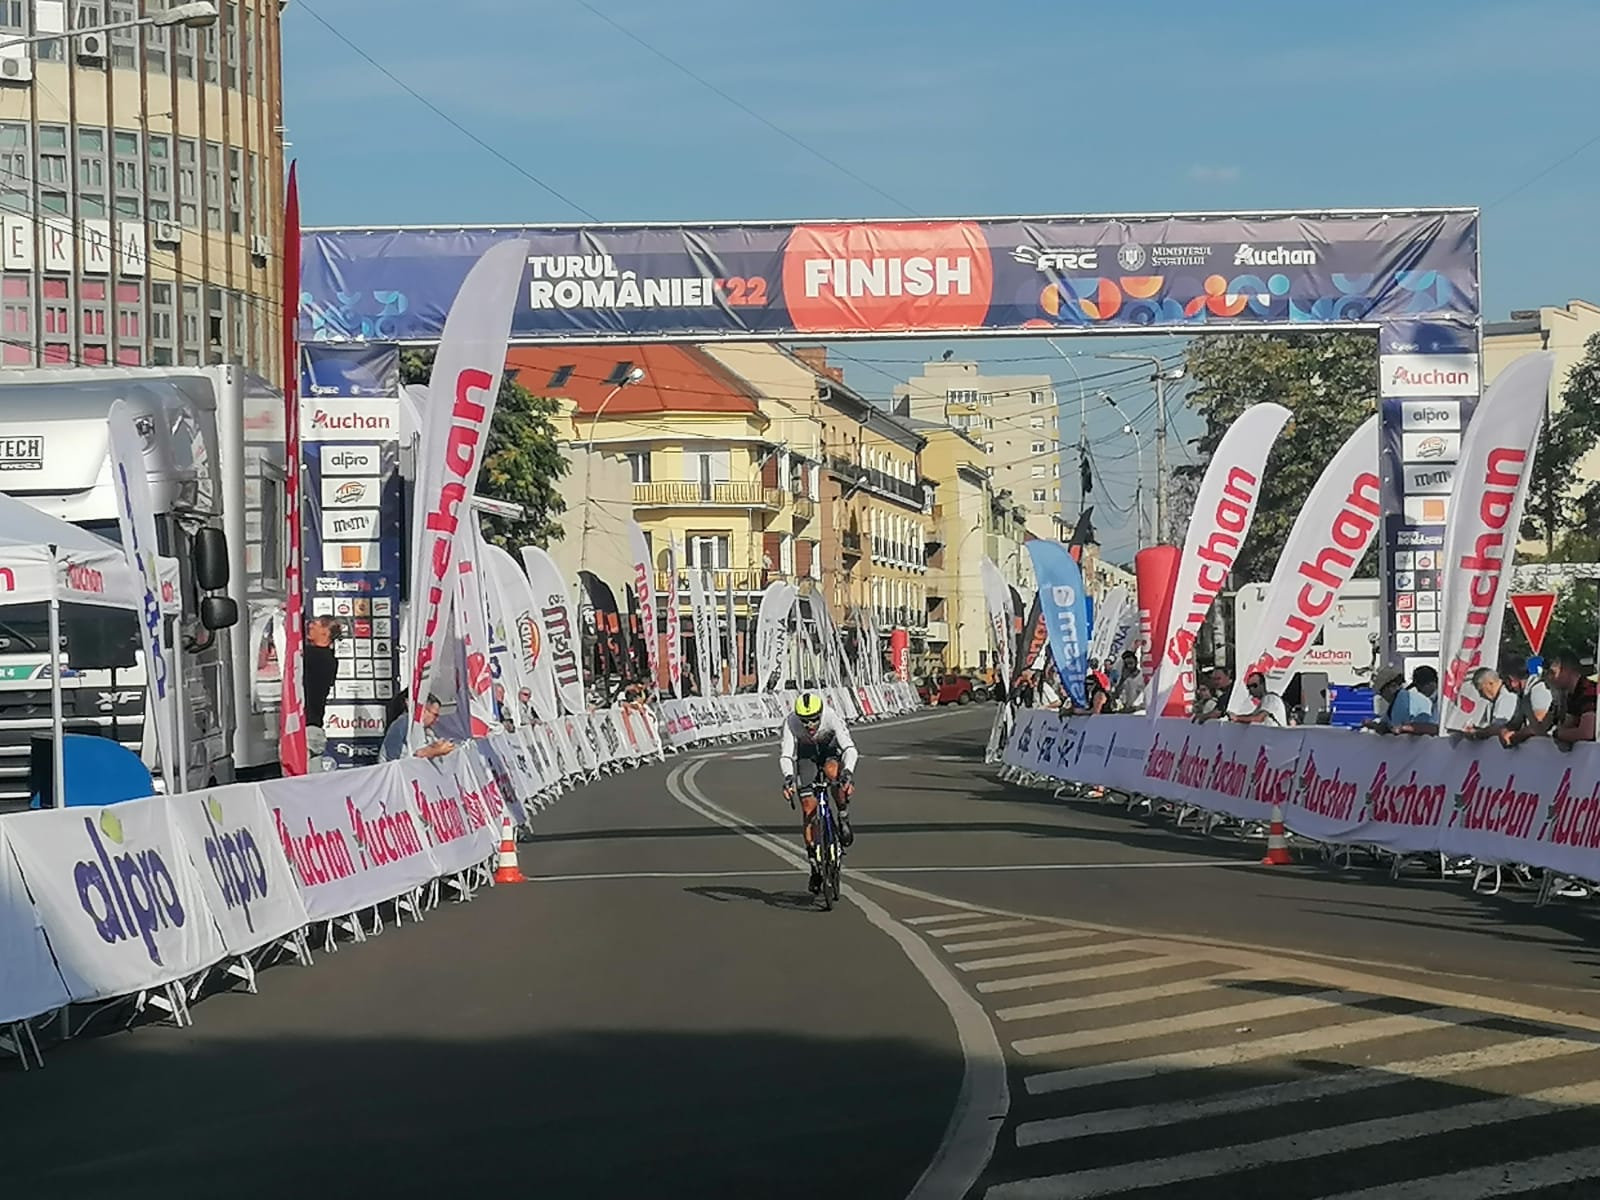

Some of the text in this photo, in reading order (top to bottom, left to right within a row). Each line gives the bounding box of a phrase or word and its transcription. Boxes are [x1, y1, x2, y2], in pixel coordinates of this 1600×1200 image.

[528, 255, 618, 278] TURUL
[1233, 243, 1316, 265] Auchan
[530, 271, 714, 309] ROMÂNIEI
[804, 257, 971, 298] FINISH
[1392, 366, 1469, 384] Auchan
[311, 409, 391, 429] Auchan
[1412, 407, 1449, 424] alpro
[331, 453, 369, 470] alpro
[1167, 466, 1257, 666] Auchan
[1442, 447, 1527, 713] Auchan
[1244, 472, 1381, 705] Auchan
[1304, 649, 1352, 660] Auchan
[325, 713, 386, 729] Auchan
[1358, 761, 1446, 826] Auchan
[1447, 760, 1540, 839] Auchan
[1537, 767, 1600, 848] Auch
[272, 808, 357, 887] Auchan
[345, 795, 423, 872] Auchan
[200, 799, 268, 934] alpro
[73, 816, 185, 967] alpro
